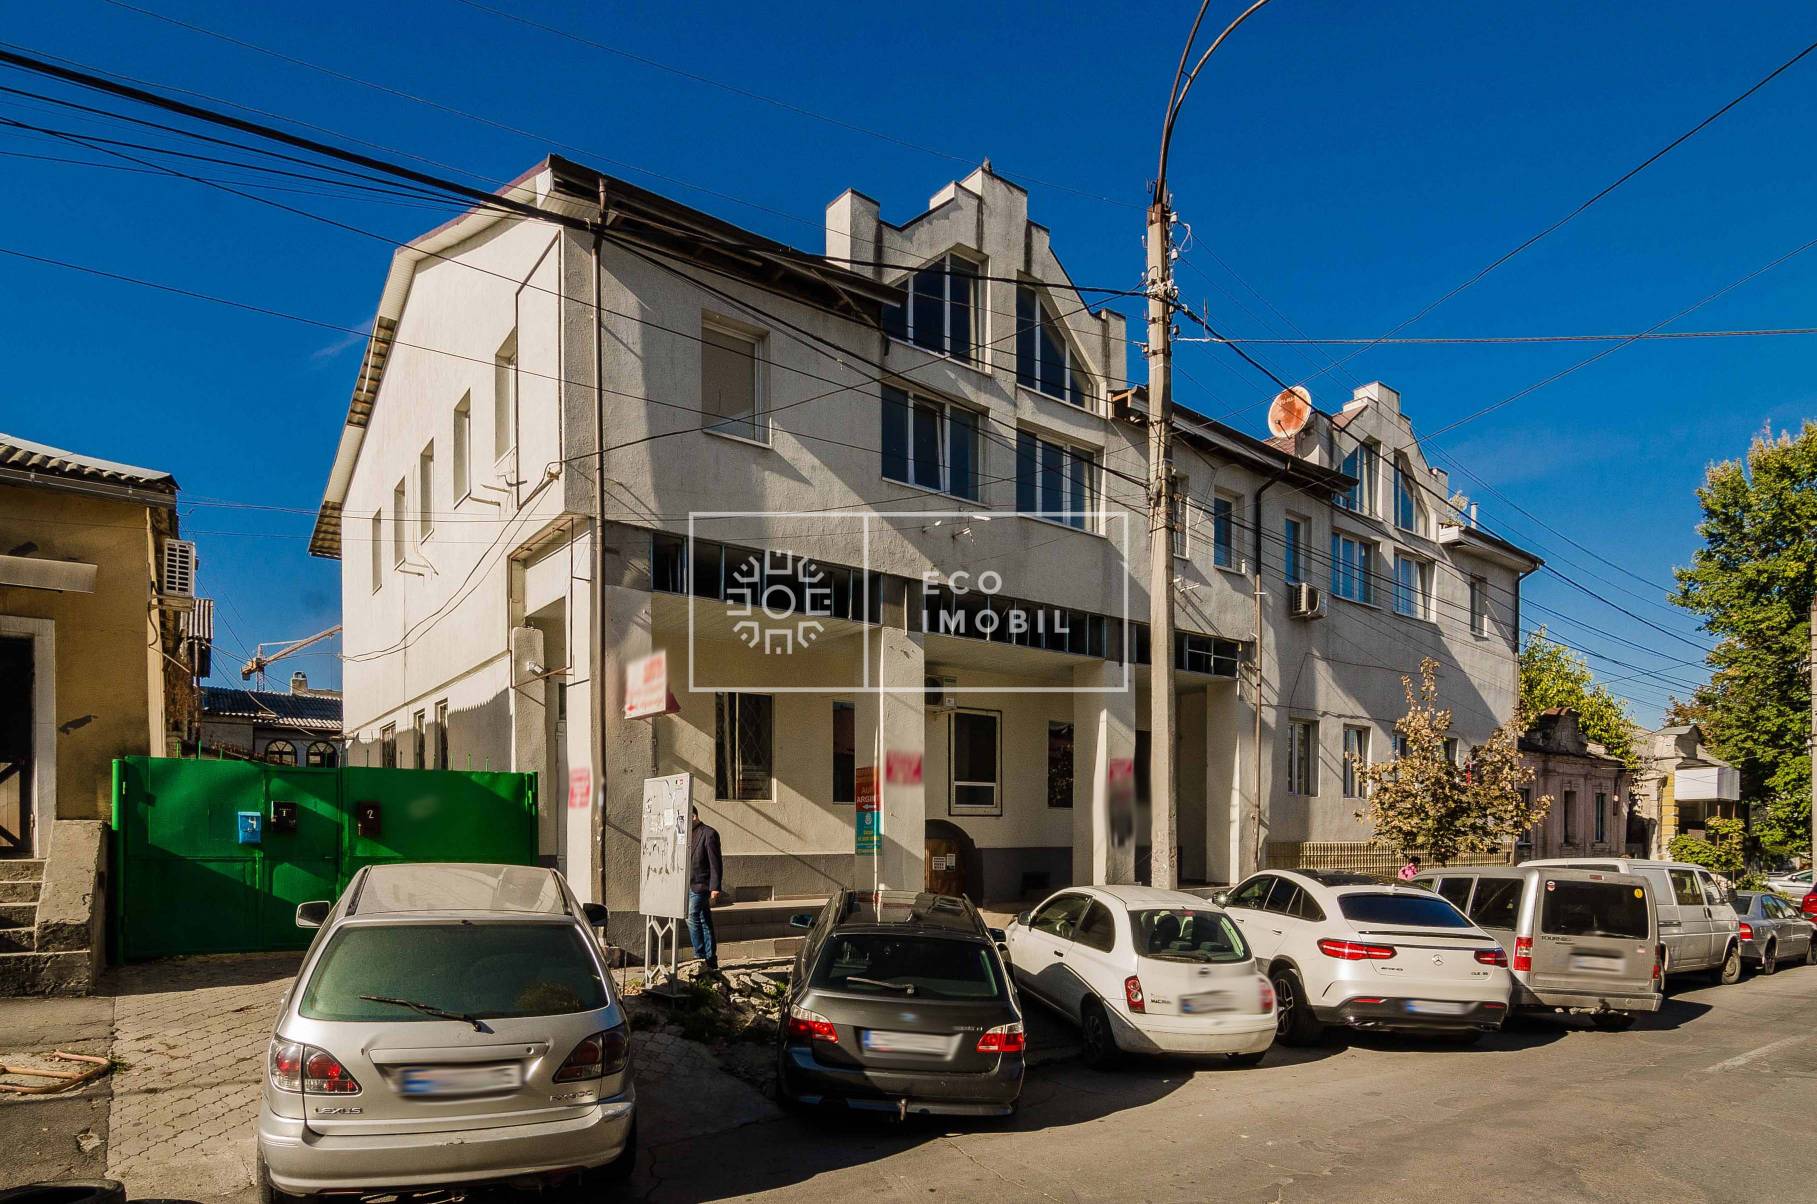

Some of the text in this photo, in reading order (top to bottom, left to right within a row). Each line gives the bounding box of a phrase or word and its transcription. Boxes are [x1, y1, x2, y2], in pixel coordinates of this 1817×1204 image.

[366, 809, 374, 819] 2
[248, 816, 257, 829] 4
[314, 1107, 363, 1115] LEXUS
